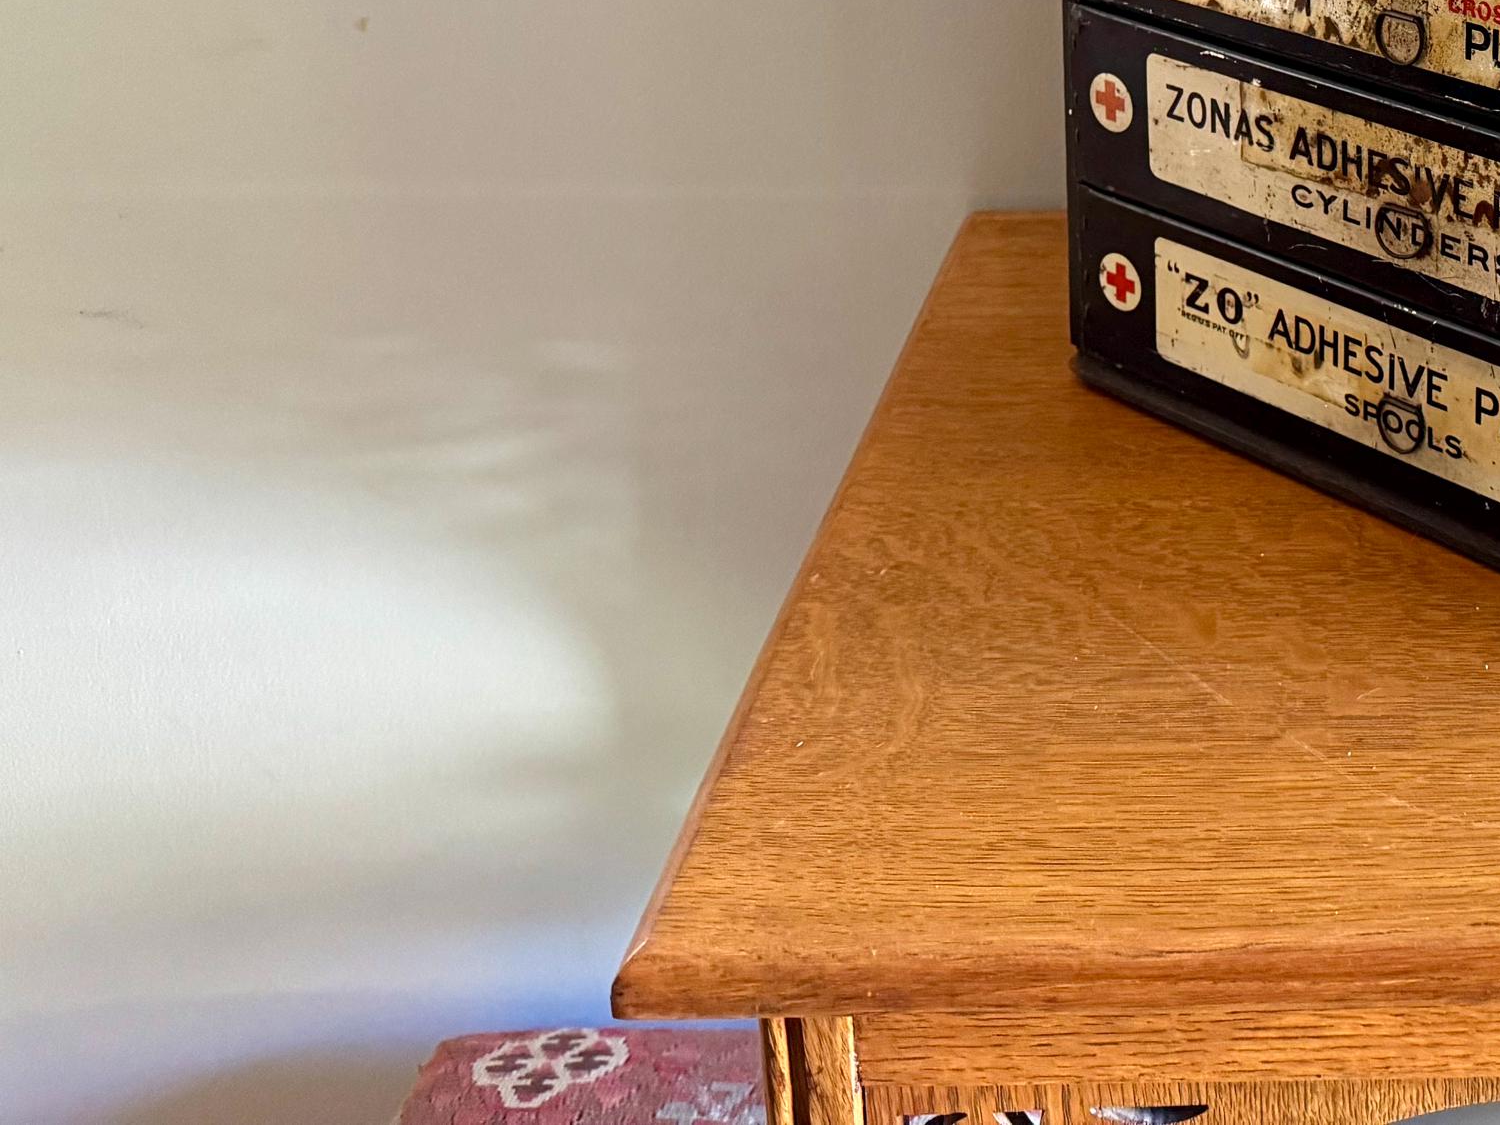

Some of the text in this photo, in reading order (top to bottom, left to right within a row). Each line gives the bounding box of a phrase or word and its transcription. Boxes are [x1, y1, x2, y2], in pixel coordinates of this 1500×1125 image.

[1166, 83, 1275, 152] ZONAS
[1268, 308, 1448, 412] ADHESIVE
[1344, 393, 1463, 460] SPOOLS
